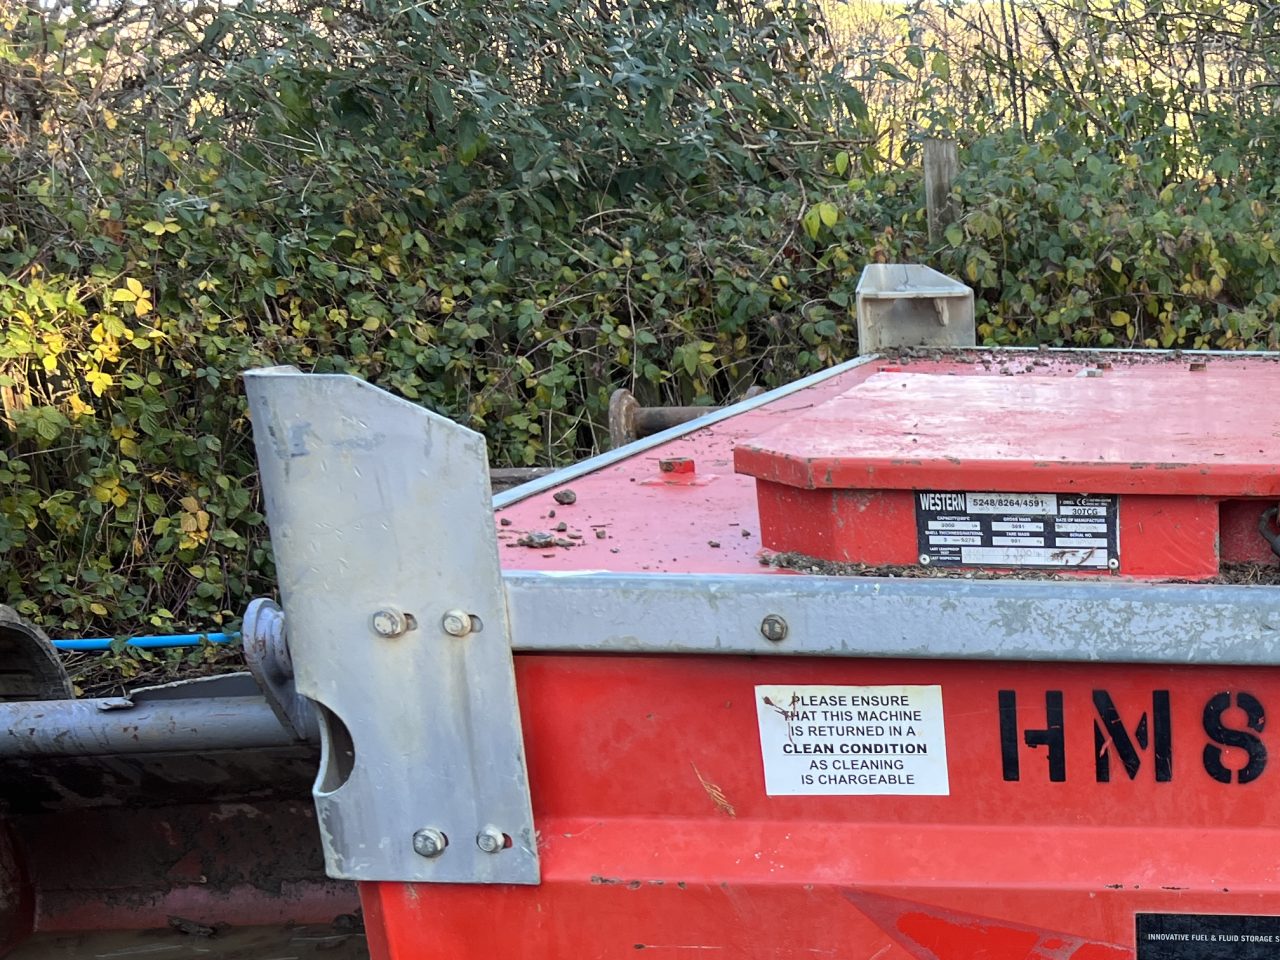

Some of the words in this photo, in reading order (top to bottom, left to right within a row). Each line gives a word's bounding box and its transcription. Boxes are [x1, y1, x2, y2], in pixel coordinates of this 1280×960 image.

[920, 493, 966, 511] WESTERN
[973, 498, 1044, 508] 5248/8264/4591
[791, 695, 847, 706] PLEASE
[851, 695, 909, 706] ENSURE
[823, 710, 853, 721] THIS
[857, 710, 922, 721] MACHINE
[791, 726, 804, 736] IS
[808, 726, 885, 736] RETURNED
[889, 726, 902, 736] IN
[906, 726, 916, 736] A
[783, 743, 834, 754] CLEAN
[839, 743, 928, 754] CONDITION
[809, 759, 828, 770] AS
[832, 759, 904, 770] CLEANING
[801, 774, 814, 785] IS
[818, 774, 915, 785] CHARGEABLE
[1148, 933, 1190, 941] INNOVATIVE
[1210, 934, 1217, 942] &
[1218, 934, 1239, 942] FLUID
[1241, 935, 1273, 943] STORAGE
